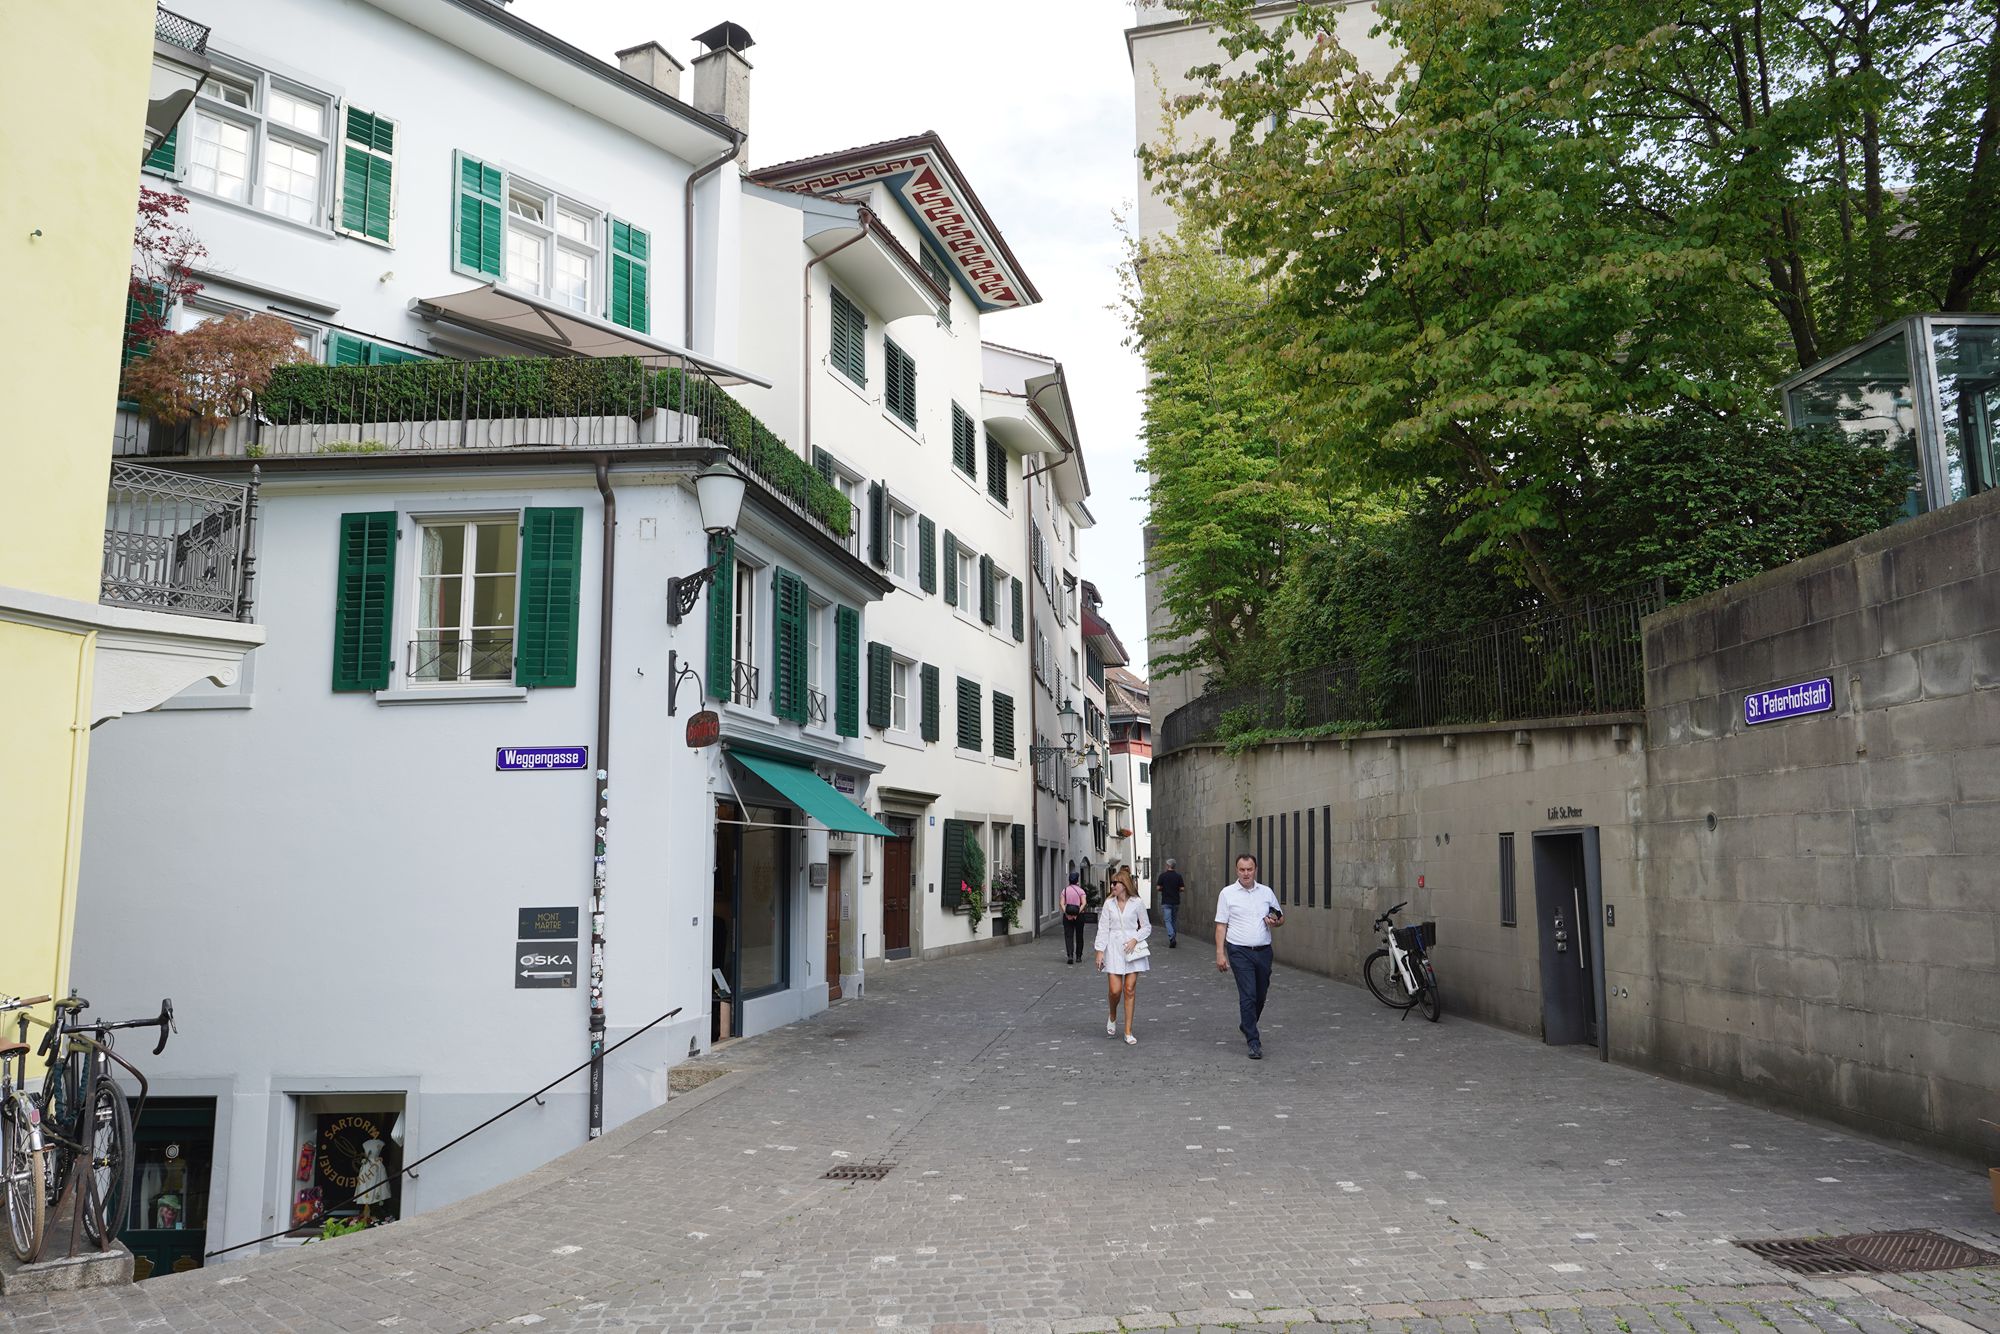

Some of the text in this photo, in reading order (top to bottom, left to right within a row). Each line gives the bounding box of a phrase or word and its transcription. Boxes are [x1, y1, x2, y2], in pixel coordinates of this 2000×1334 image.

[1748, 683, 1826, 717] St. Peterhofstatt
[505, 750, 578, 767] Weggengasse
[1547, 806, 1583, 820] Lift St. Peter
[537, 912, 559, 921] MONT
[534, 921, 561, 929] MARTRE
[520, 955, 573, 966] OSKA
[324, 1117, 380, 1140] SARTORIA
